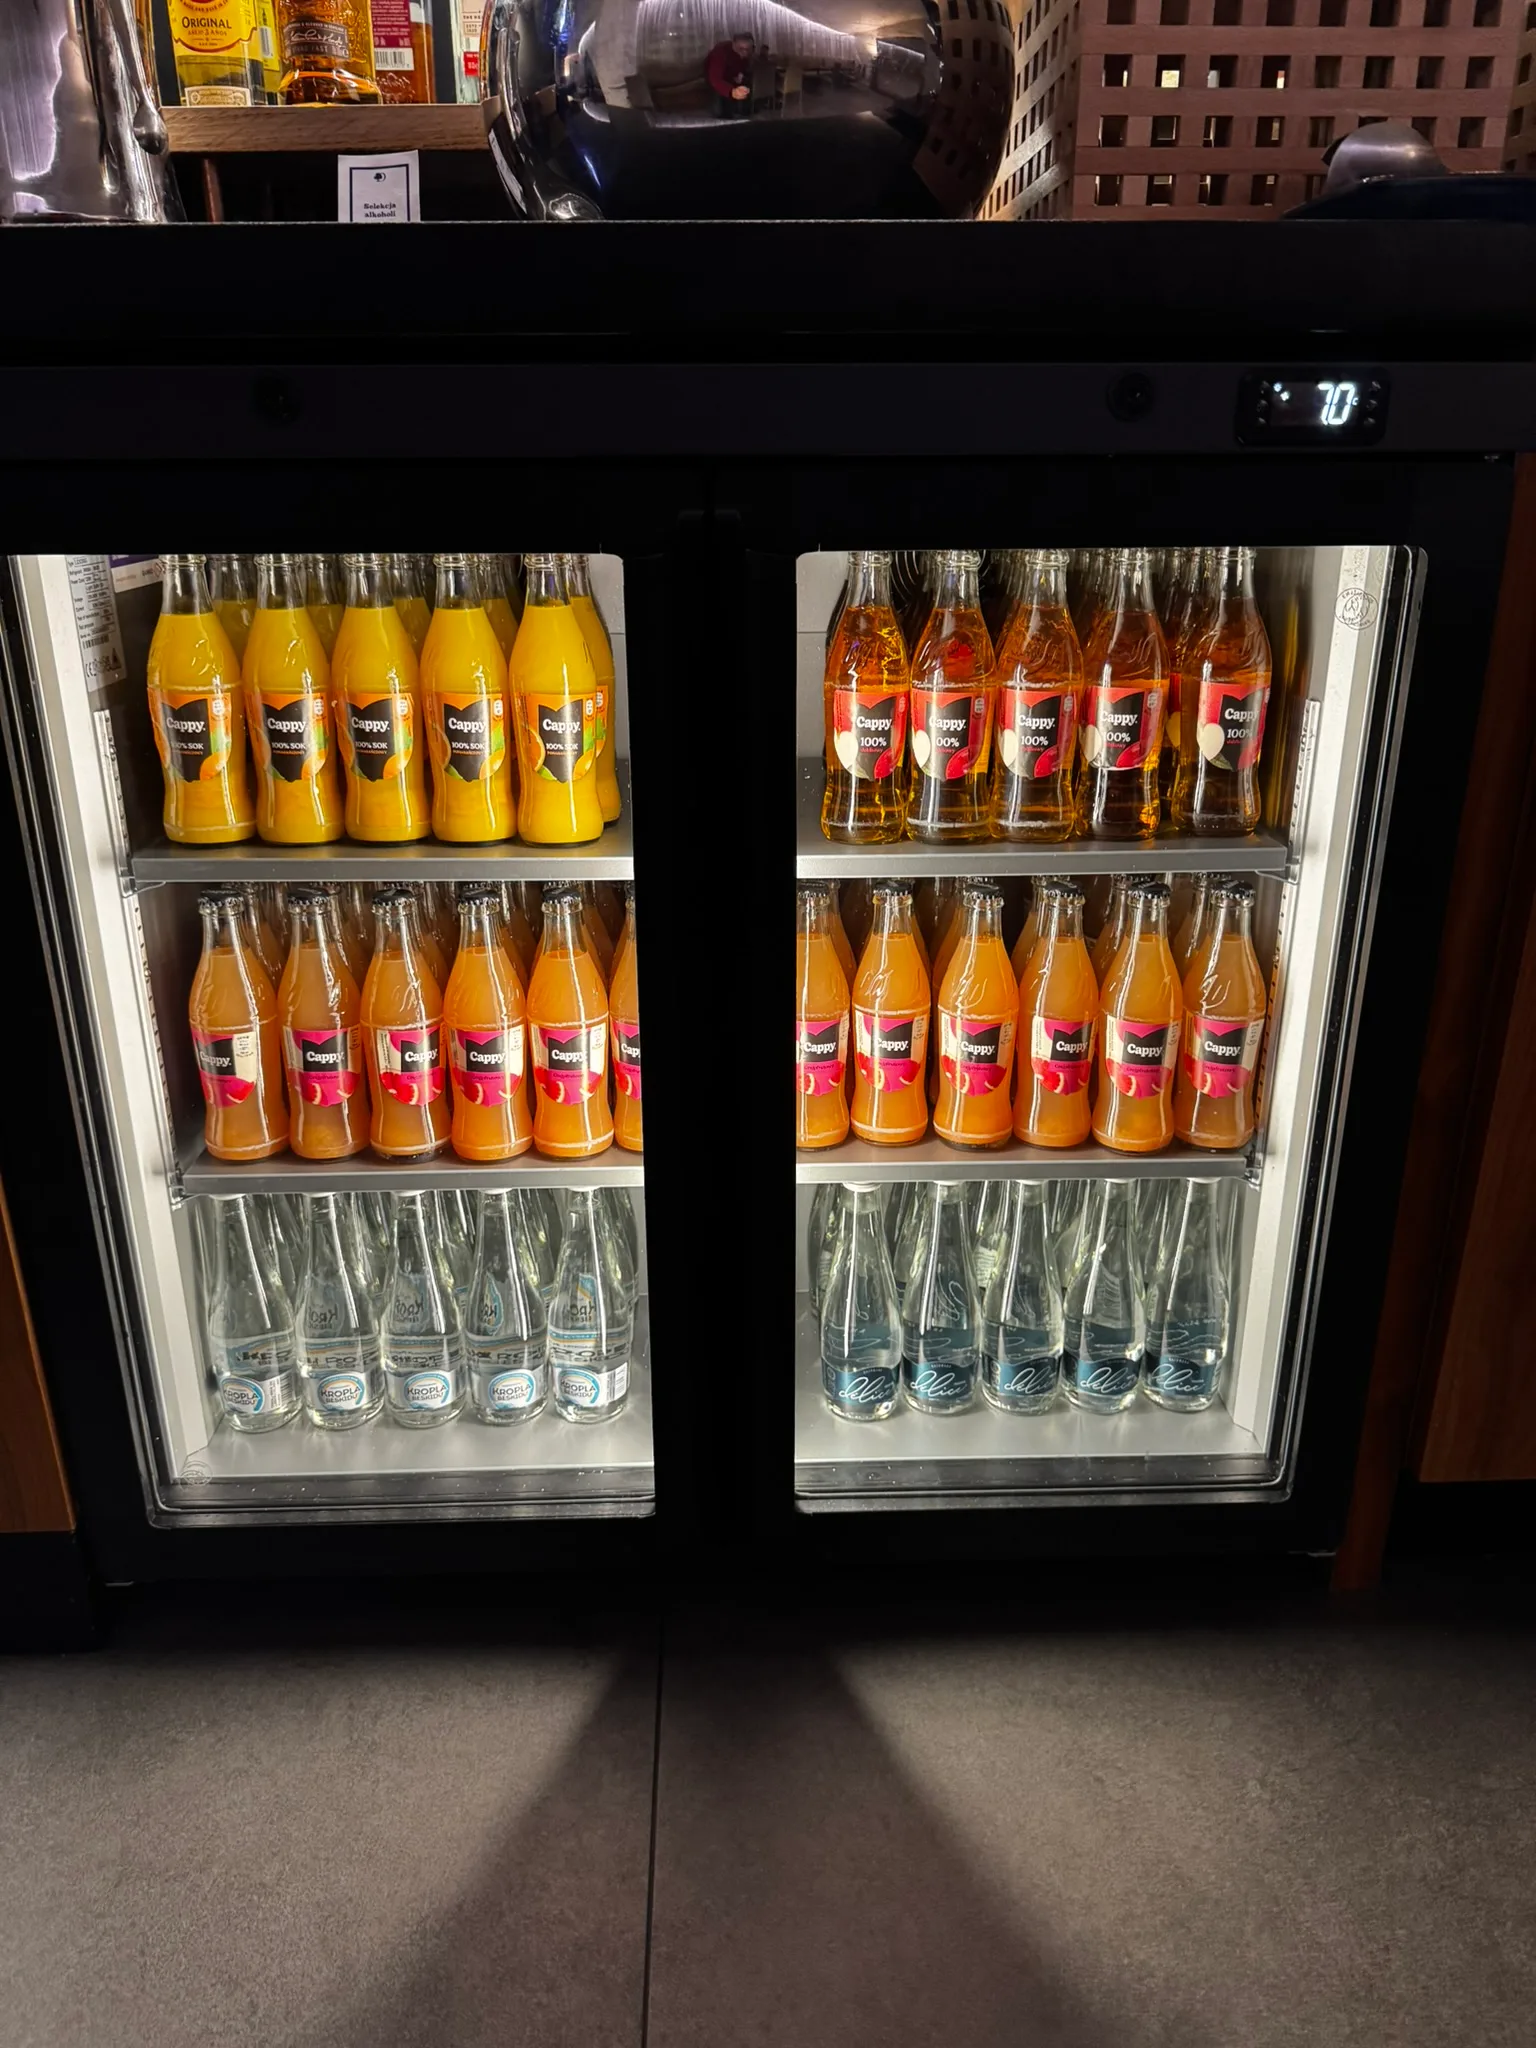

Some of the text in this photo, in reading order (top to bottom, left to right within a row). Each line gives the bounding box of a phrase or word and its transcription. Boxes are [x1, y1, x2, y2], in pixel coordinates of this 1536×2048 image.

[182, 16, 232, 29] ORIGINAL
[363, 202, 397, 210] Selekcja
[364, 210, 396, 218] alkoholi
[290, 742, 307, 750] SOK
[860, 736, 887, 747] 100%
[1021, 735, 1048, 746] 100%
[223, 1388, 258, 1400] KROPLA
[320, 1386, 362, 1397] KROPLA
[407, 1384, 447, 1396] KROPLA
[492, 1384, 532, 1396] KROPLA
